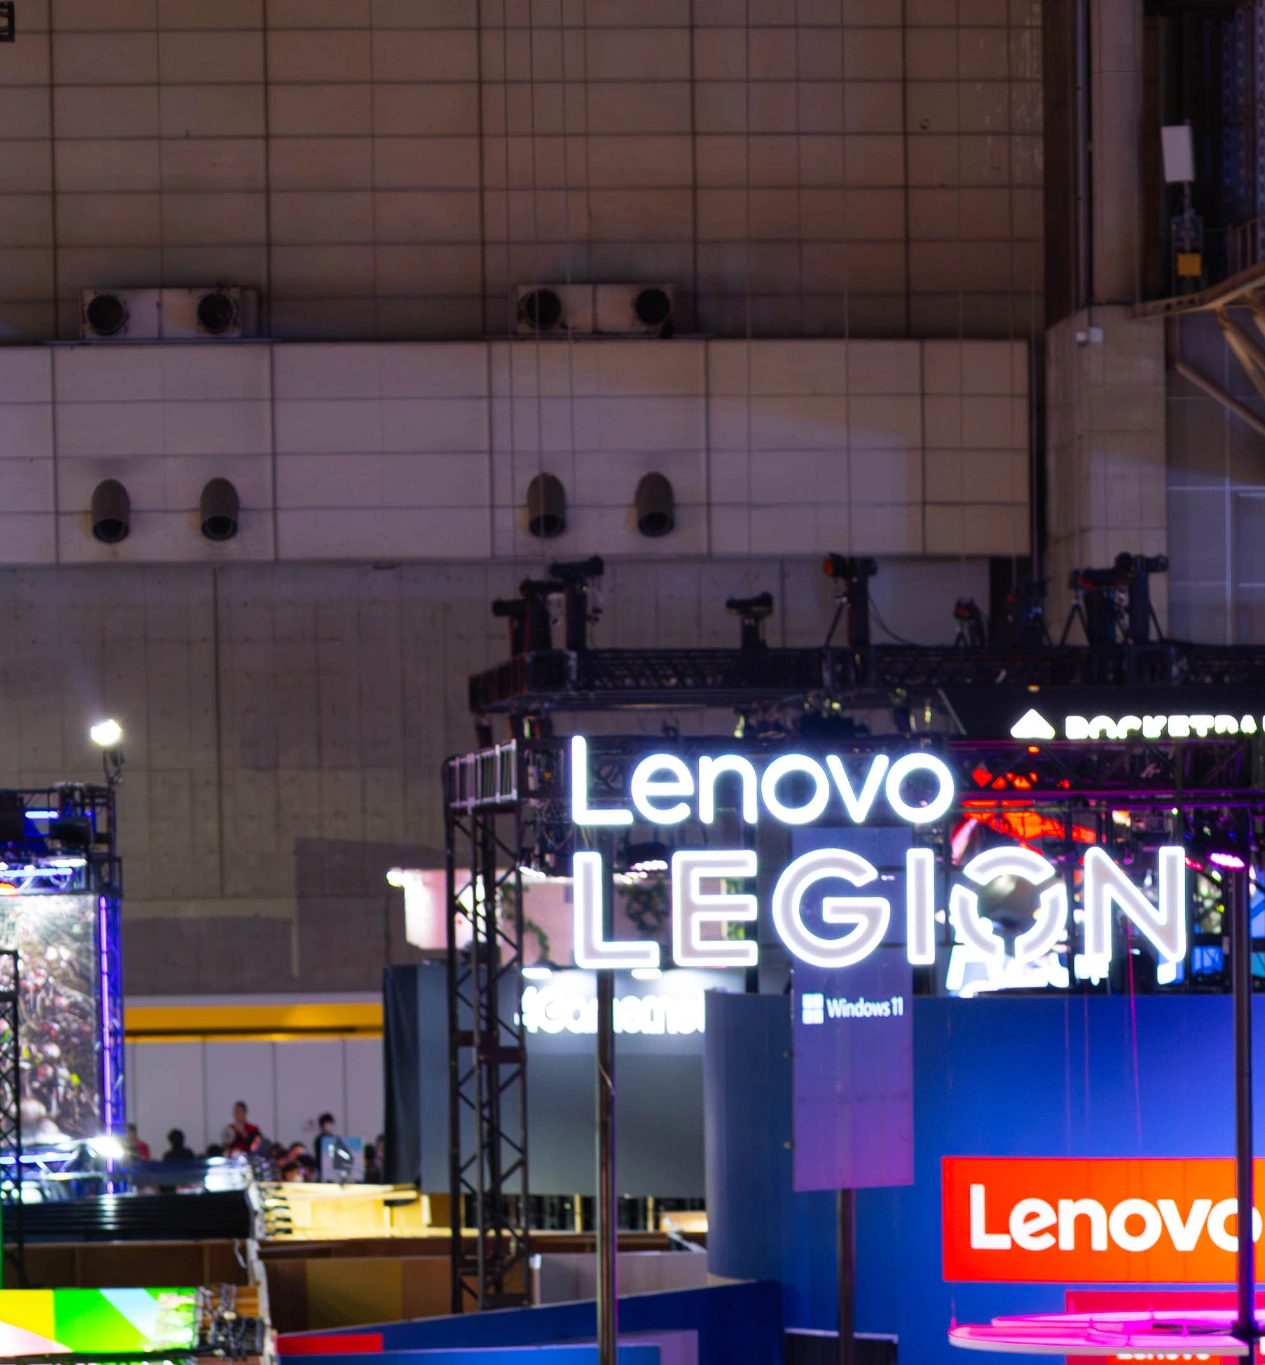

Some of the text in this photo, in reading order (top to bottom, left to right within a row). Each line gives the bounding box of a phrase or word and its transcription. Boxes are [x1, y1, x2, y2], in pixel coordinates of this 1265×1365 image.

[571, 735, 956, 826] Lenovo
[572, 846, 1187, 969] LEGION
[827, 996, 904, 1018] Windows 11
[969, 1184, 1263, 1252] Lenovo
